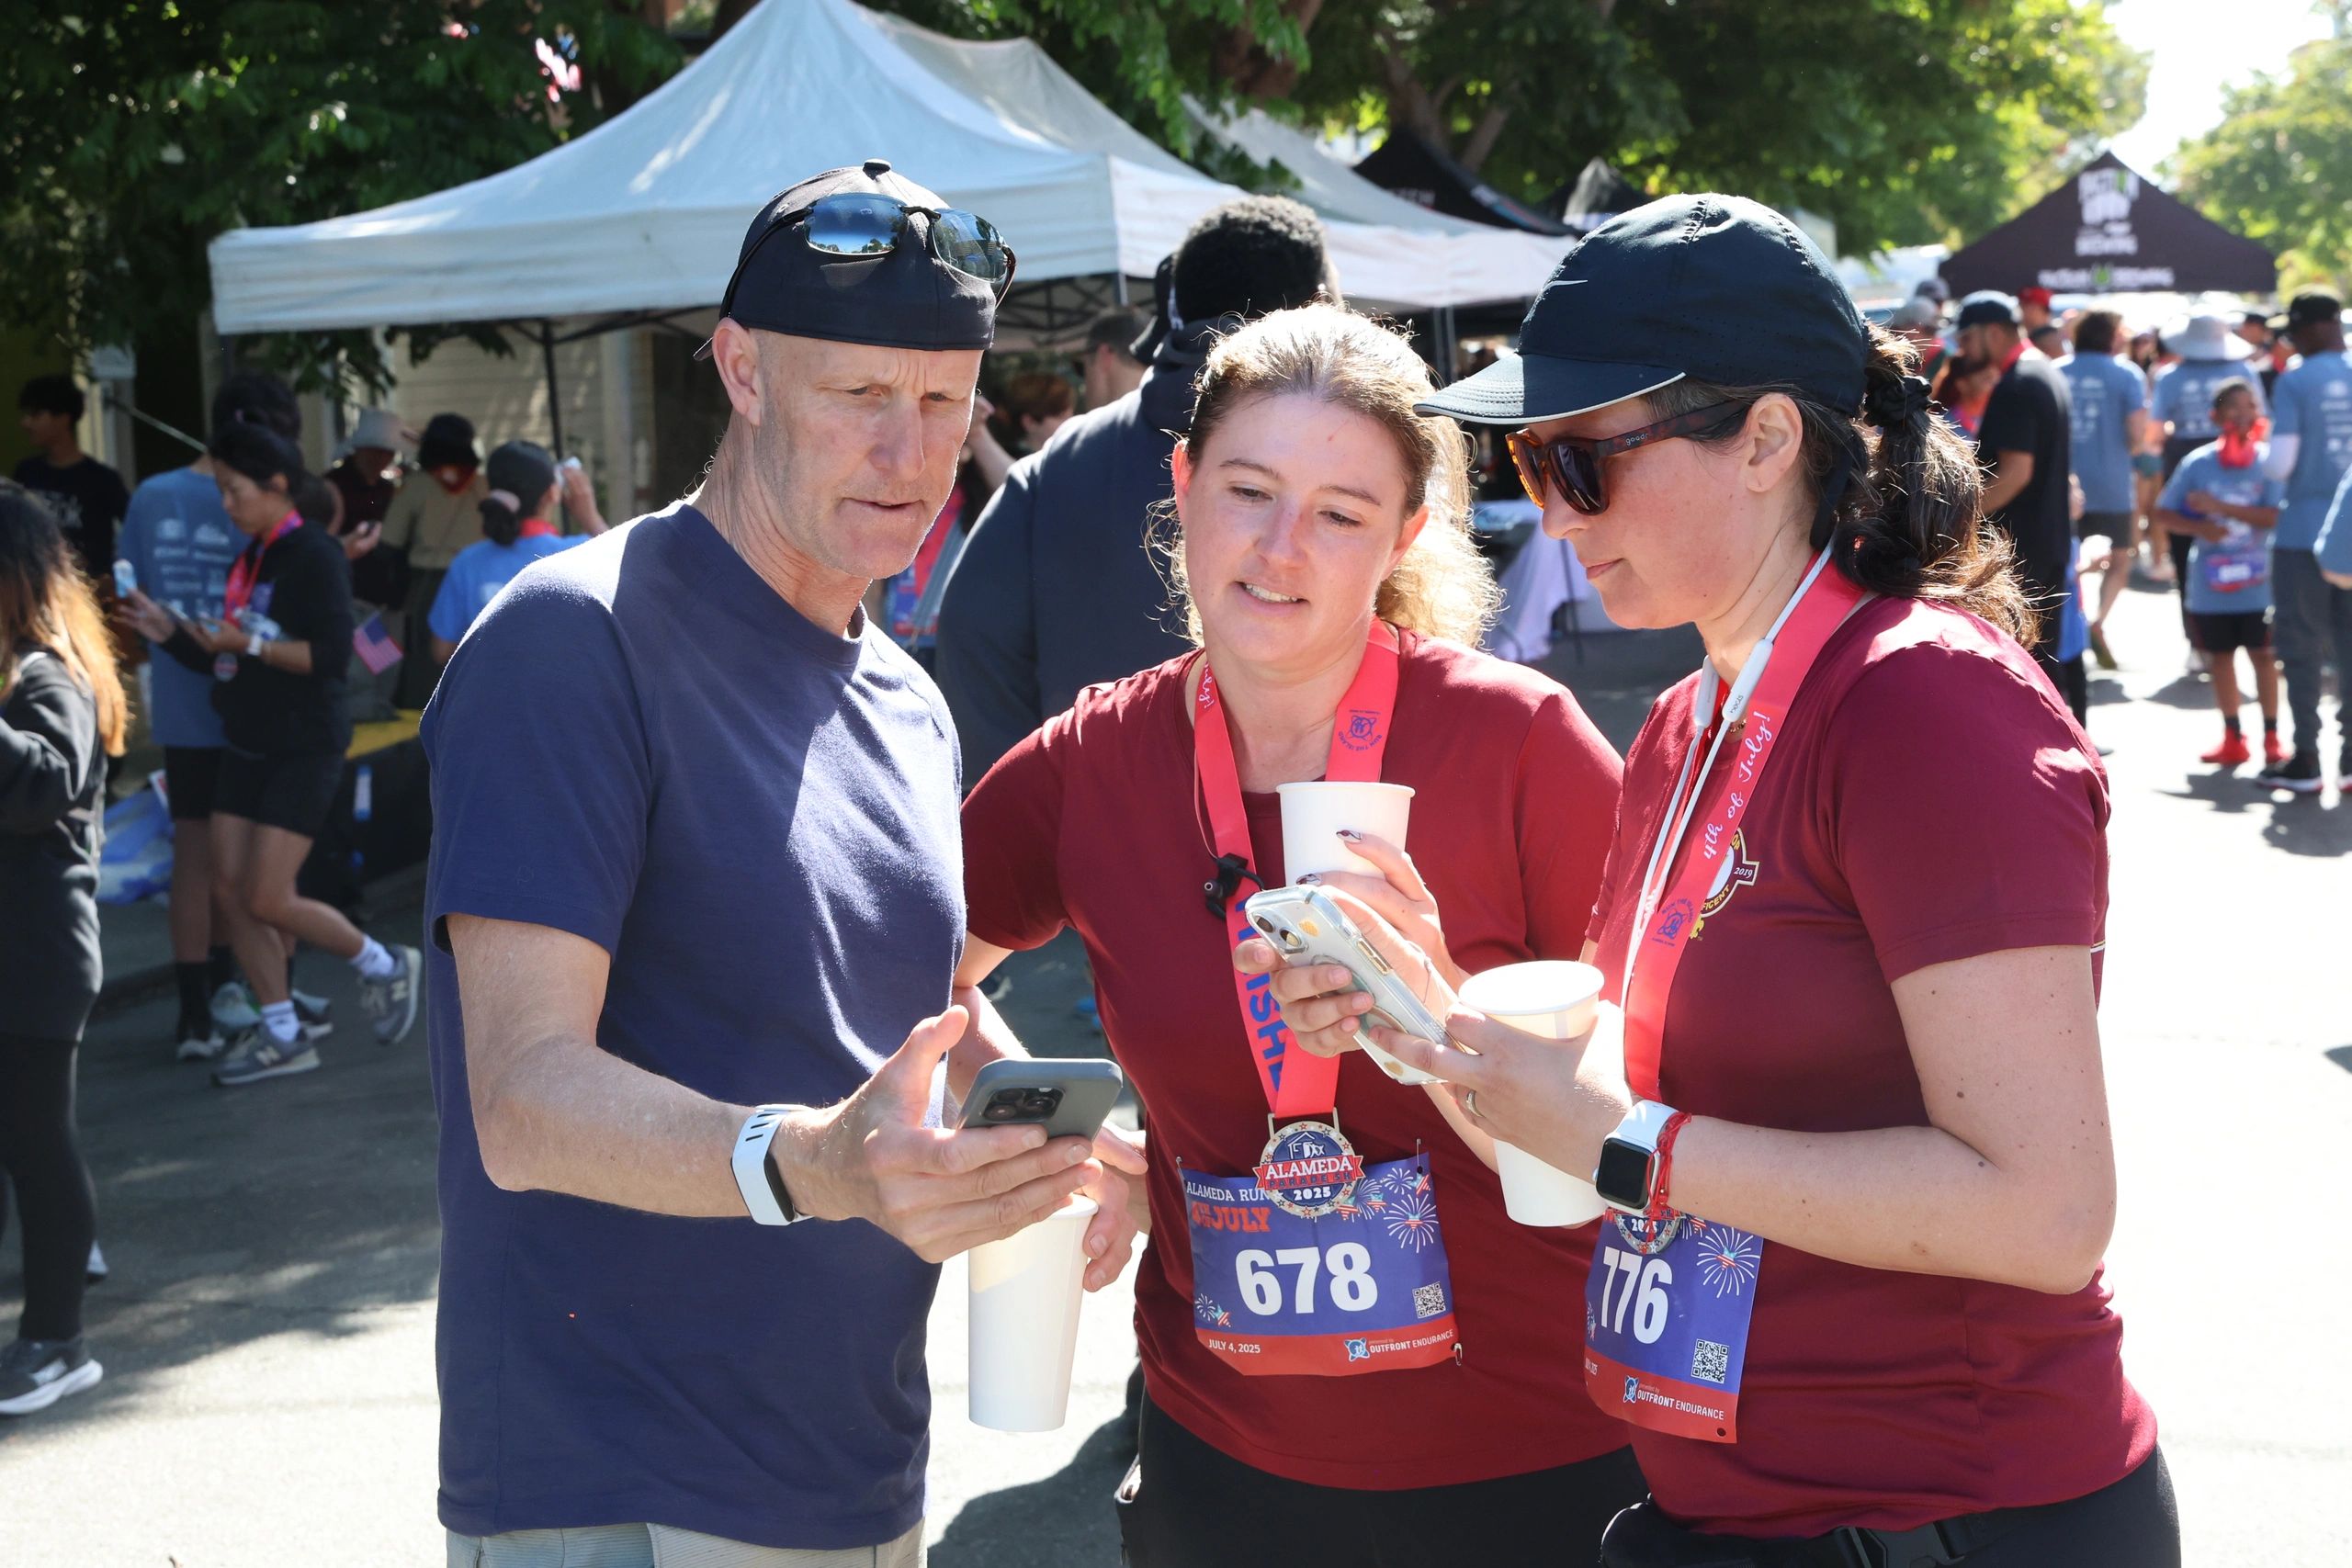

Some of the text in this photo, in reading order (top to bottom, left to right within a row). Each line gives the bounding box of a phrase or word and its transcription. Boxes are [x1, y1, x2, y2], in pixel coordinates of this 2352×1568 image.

[1626, 433, 1648, 446] goodr
[1703, 711, 1772, 860] 4th of July!
[1734, 867, 1753, 879] 2019
[1265, 1156, 1353, 1180] ALAMEDA
[1186, 1181, 1235, 1201] ALAMEDA
[1269, 1174, 1329, 1188] PARADE
[1293, 1186, 1331, 1201] 2025
[1213, 1205, 1272, 1233] JULY
[1235, 1242, 1378, 1316] 678
[1601, 1246, 1673, 1345] 776
[1208, 1338, 1261, 1354] JULY 4, 2025
[1369, 1340, 1411, 1354] OUTFRONT
[1412, 1329, 1453, 1348] ENDURANCE
[1637, 1389, 1724, 1420] OUTFRONT ENDURANCE
